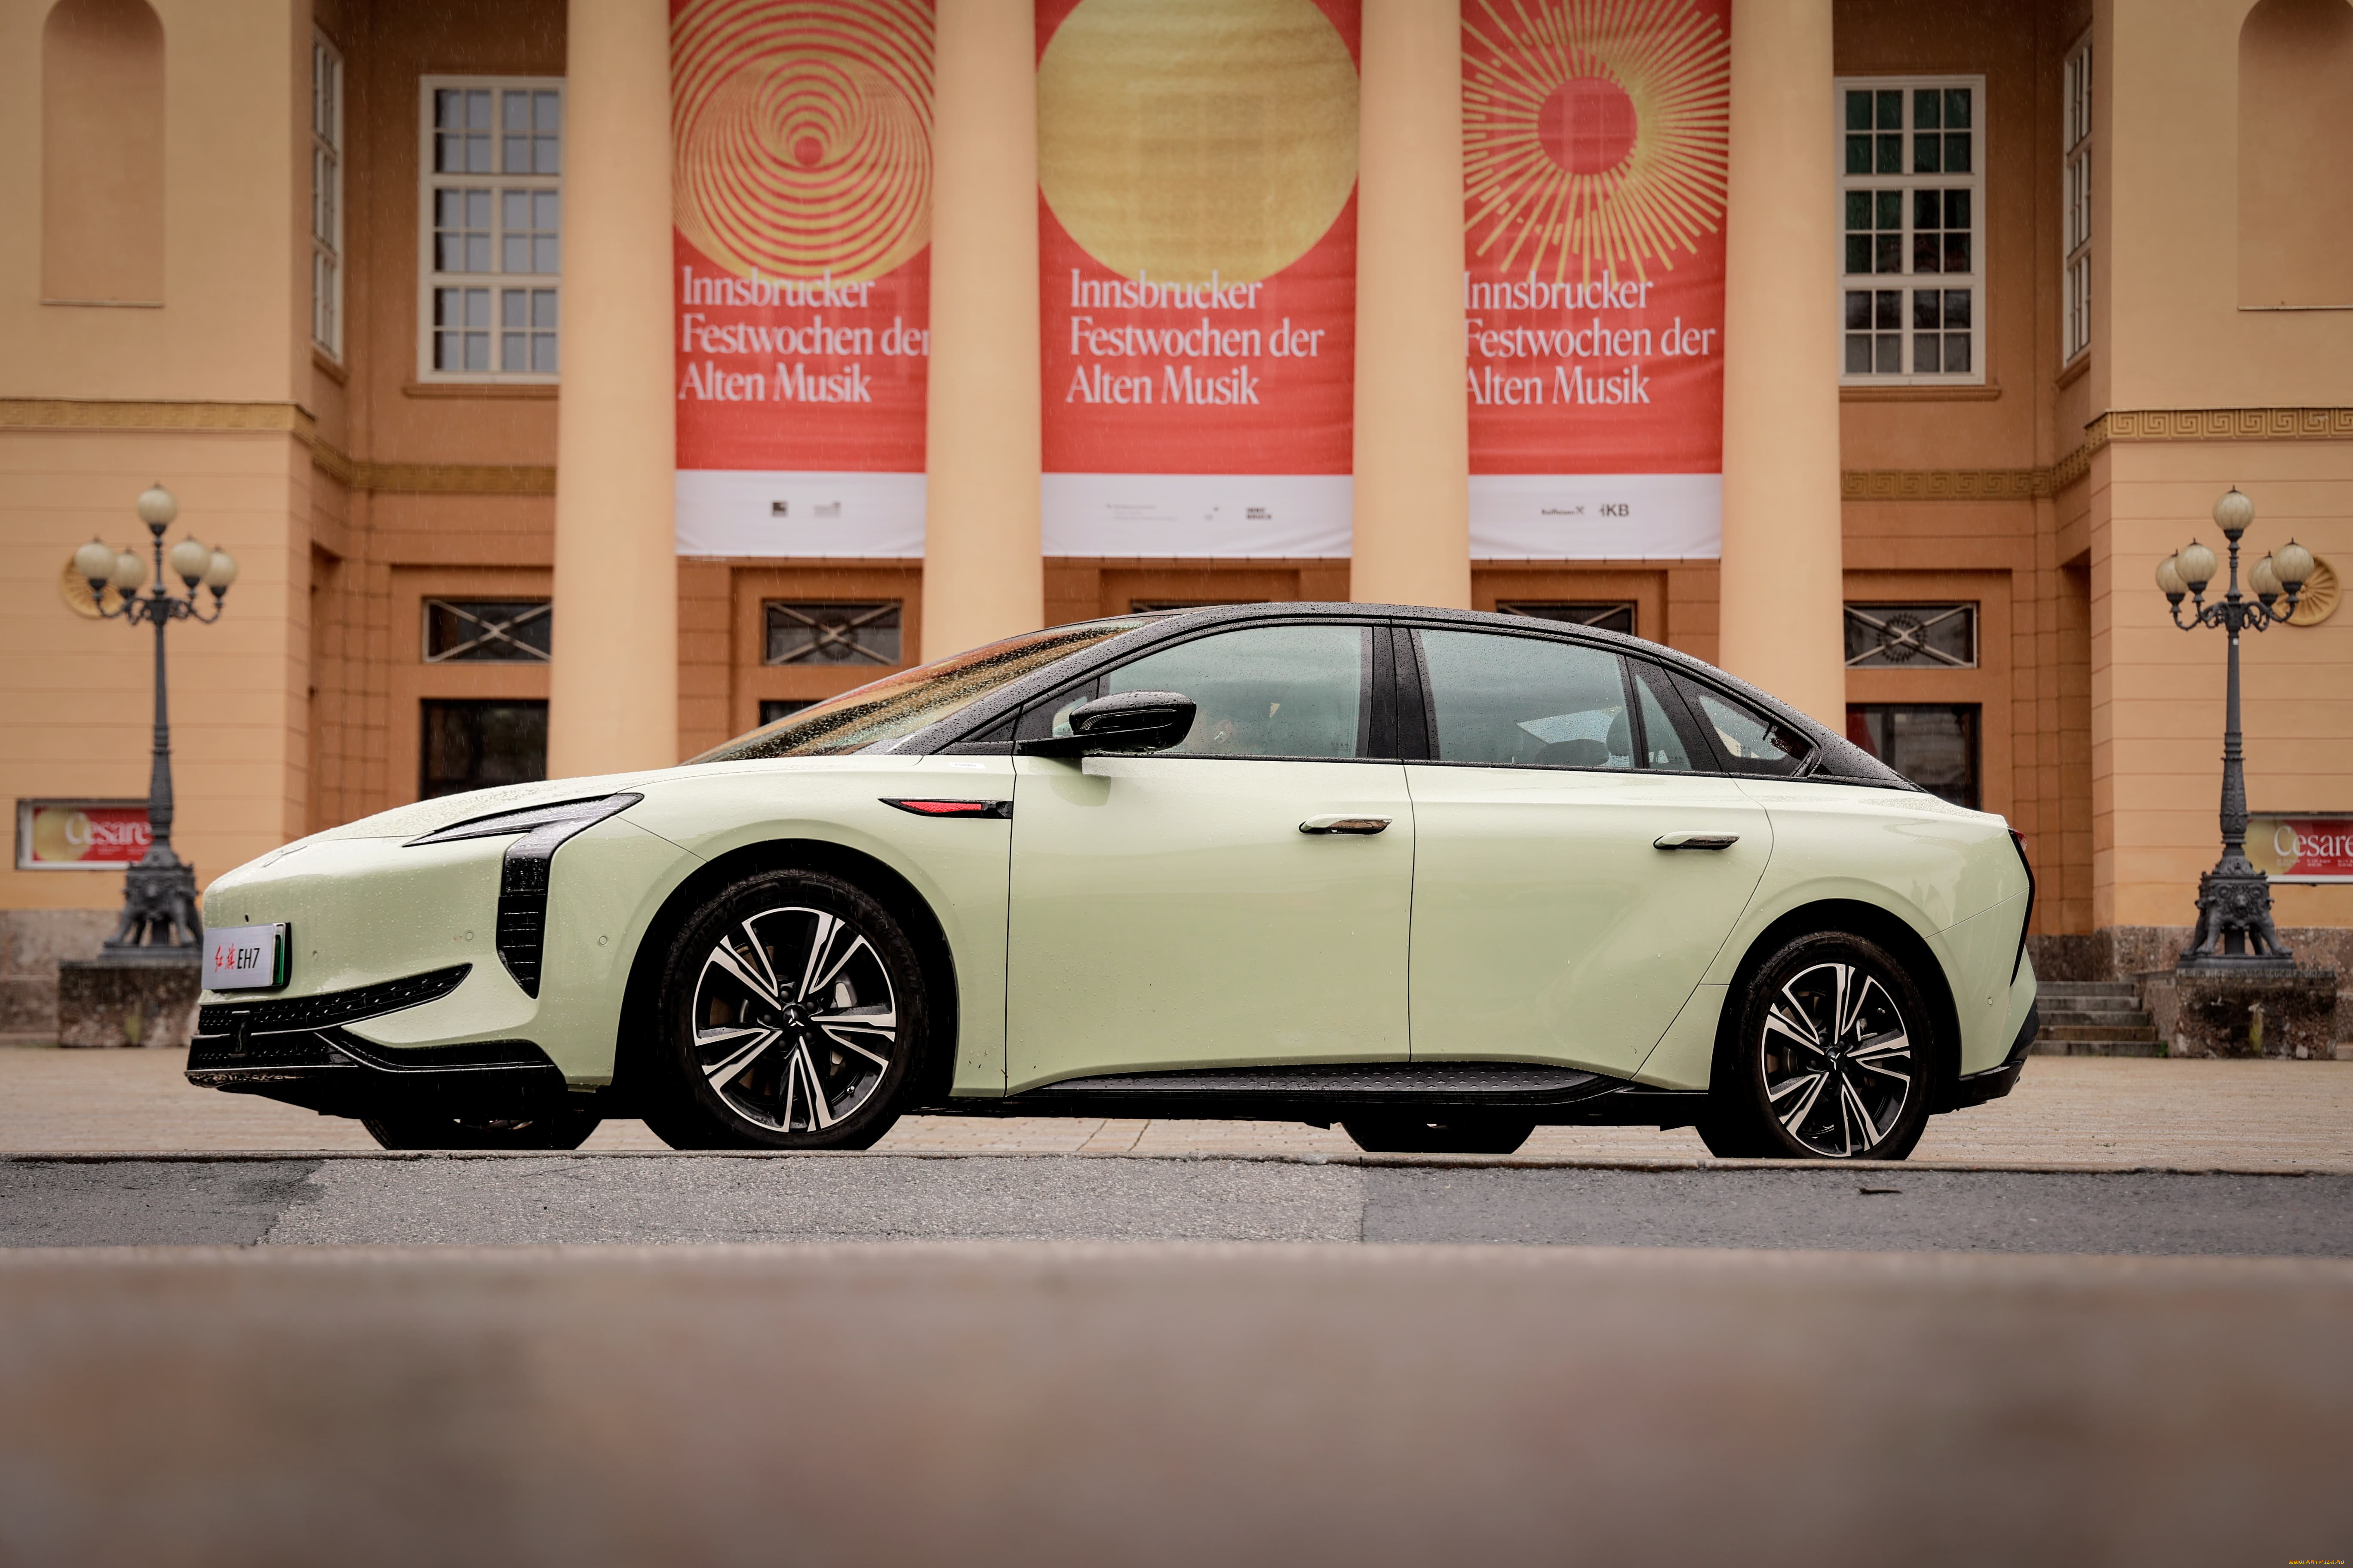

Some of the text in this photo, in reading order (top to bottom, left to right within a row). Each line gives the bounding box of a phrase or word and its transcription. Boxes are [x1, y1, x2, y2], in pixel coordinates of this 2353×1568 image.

[683, 265, 875, 307] Innsbrucker
[1070, 268, 1263, 309] Innsbrucker
[1464, 269, 1653, 310] Innsbrucker
[682, 313, 929, 356] Festwochen der
[1070, 316, 1325, 357] Festwochen der
[1465, 316, 1716, 357] Festwochen der
[678, 360, 872, 403] Alten Musik
[1065, 363, 1260, 405] Alten Musik
[1466, 364, 1650, 405] Alten Musik
[65, 811, 153, 846] Cesare
[2274, 825, 2353, 857] Cesare
[237, 948, 260, 969] EH7
